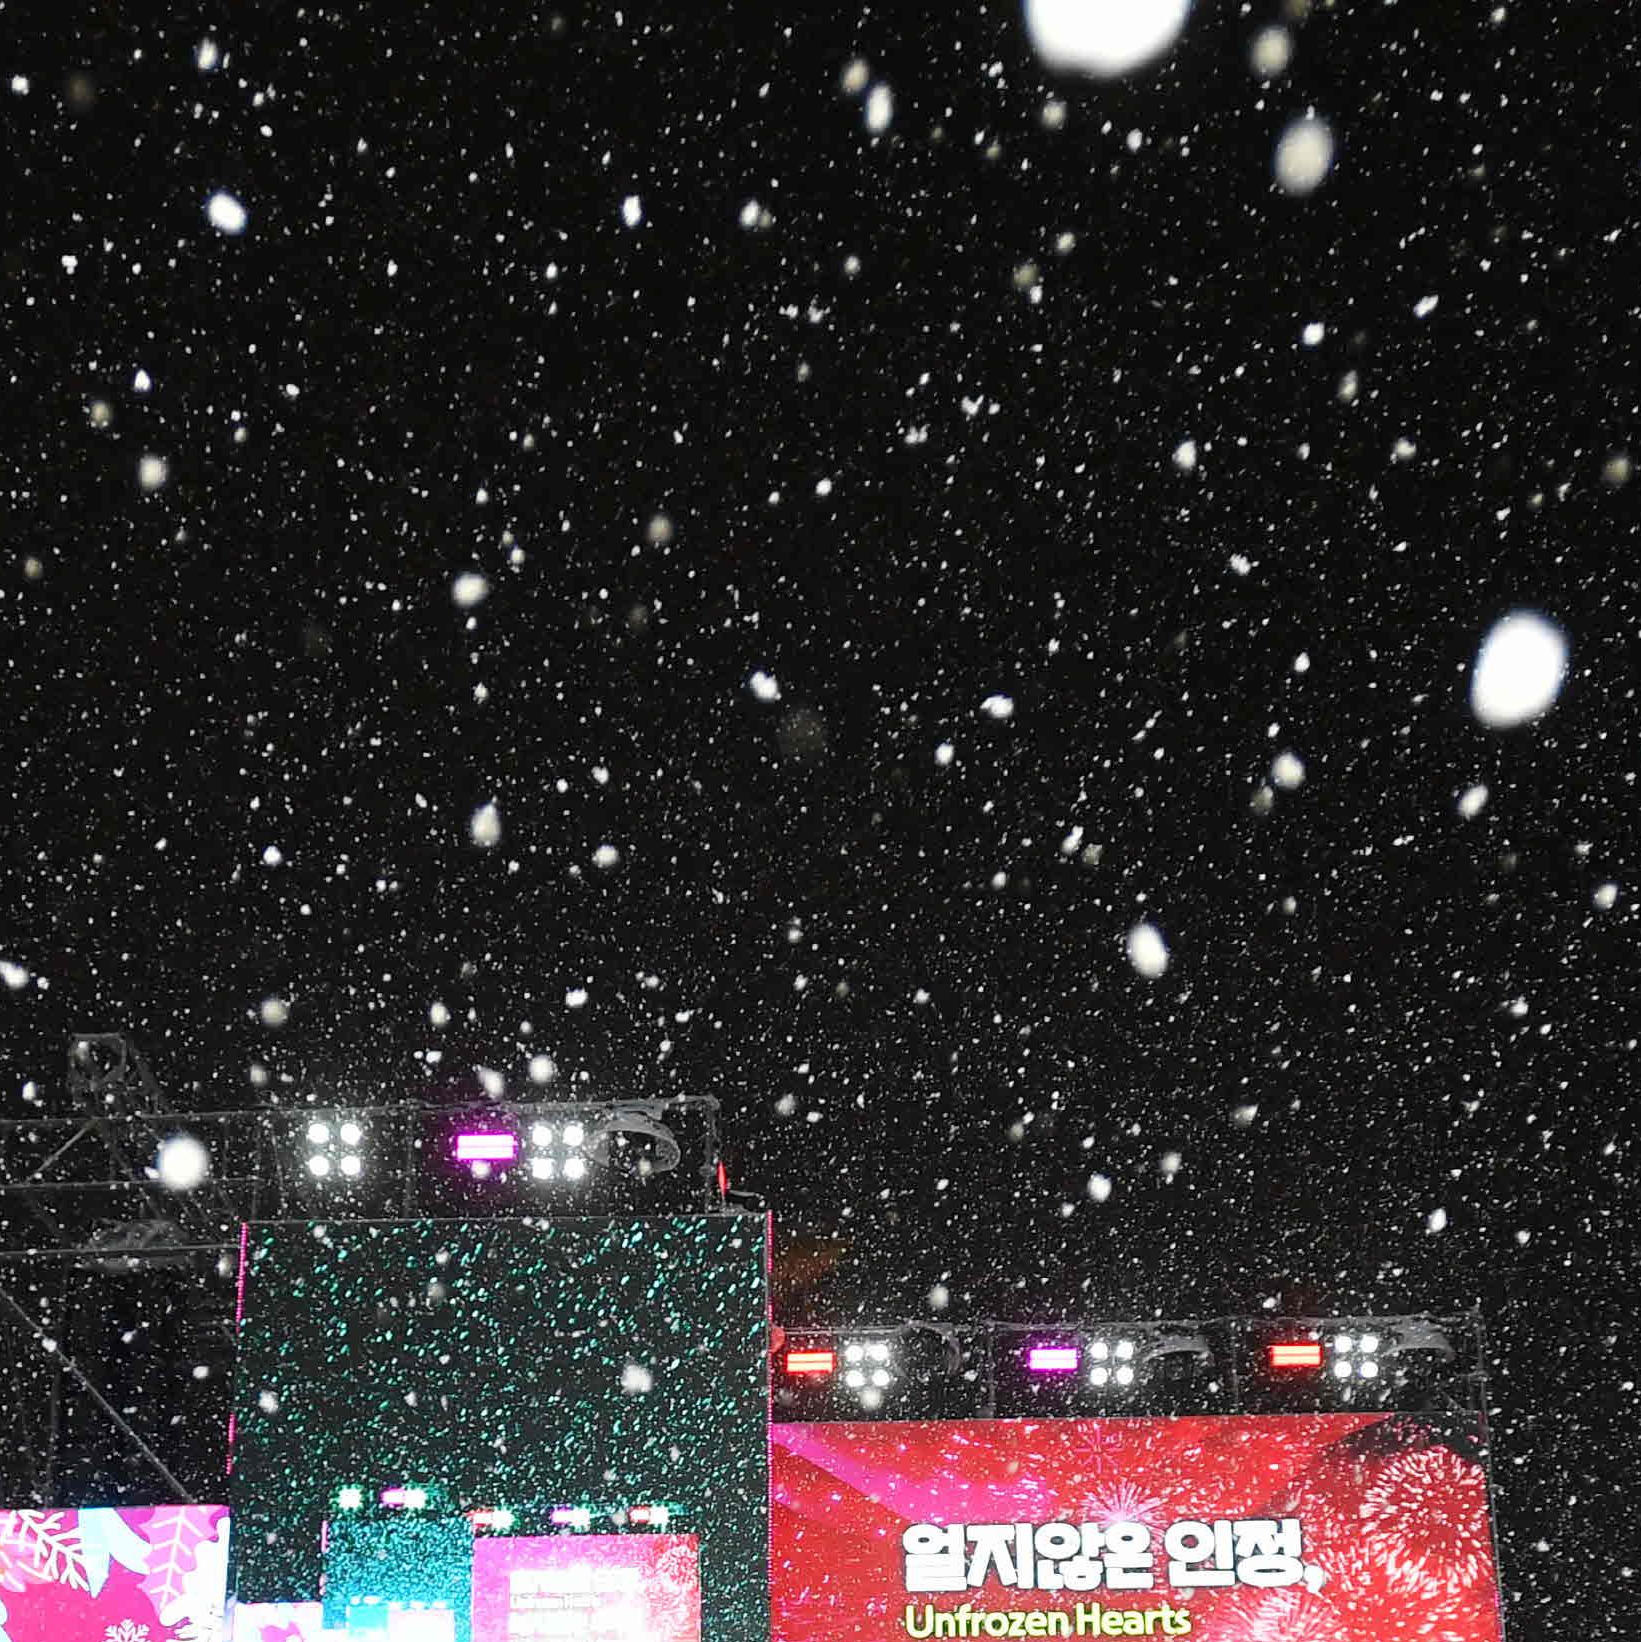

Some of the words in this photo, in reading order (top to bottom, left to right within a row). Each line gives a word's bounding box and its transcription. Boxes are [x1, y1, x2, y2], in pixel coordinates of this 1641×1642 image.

[903, 1520, 1157, 1594] 얼지않은
[1165, 1518, 1326, 1594] 인정,
[904, 1603, 1072, 1640] Unfrozen
[1075, 1602, 1192, 1638] Hearts
